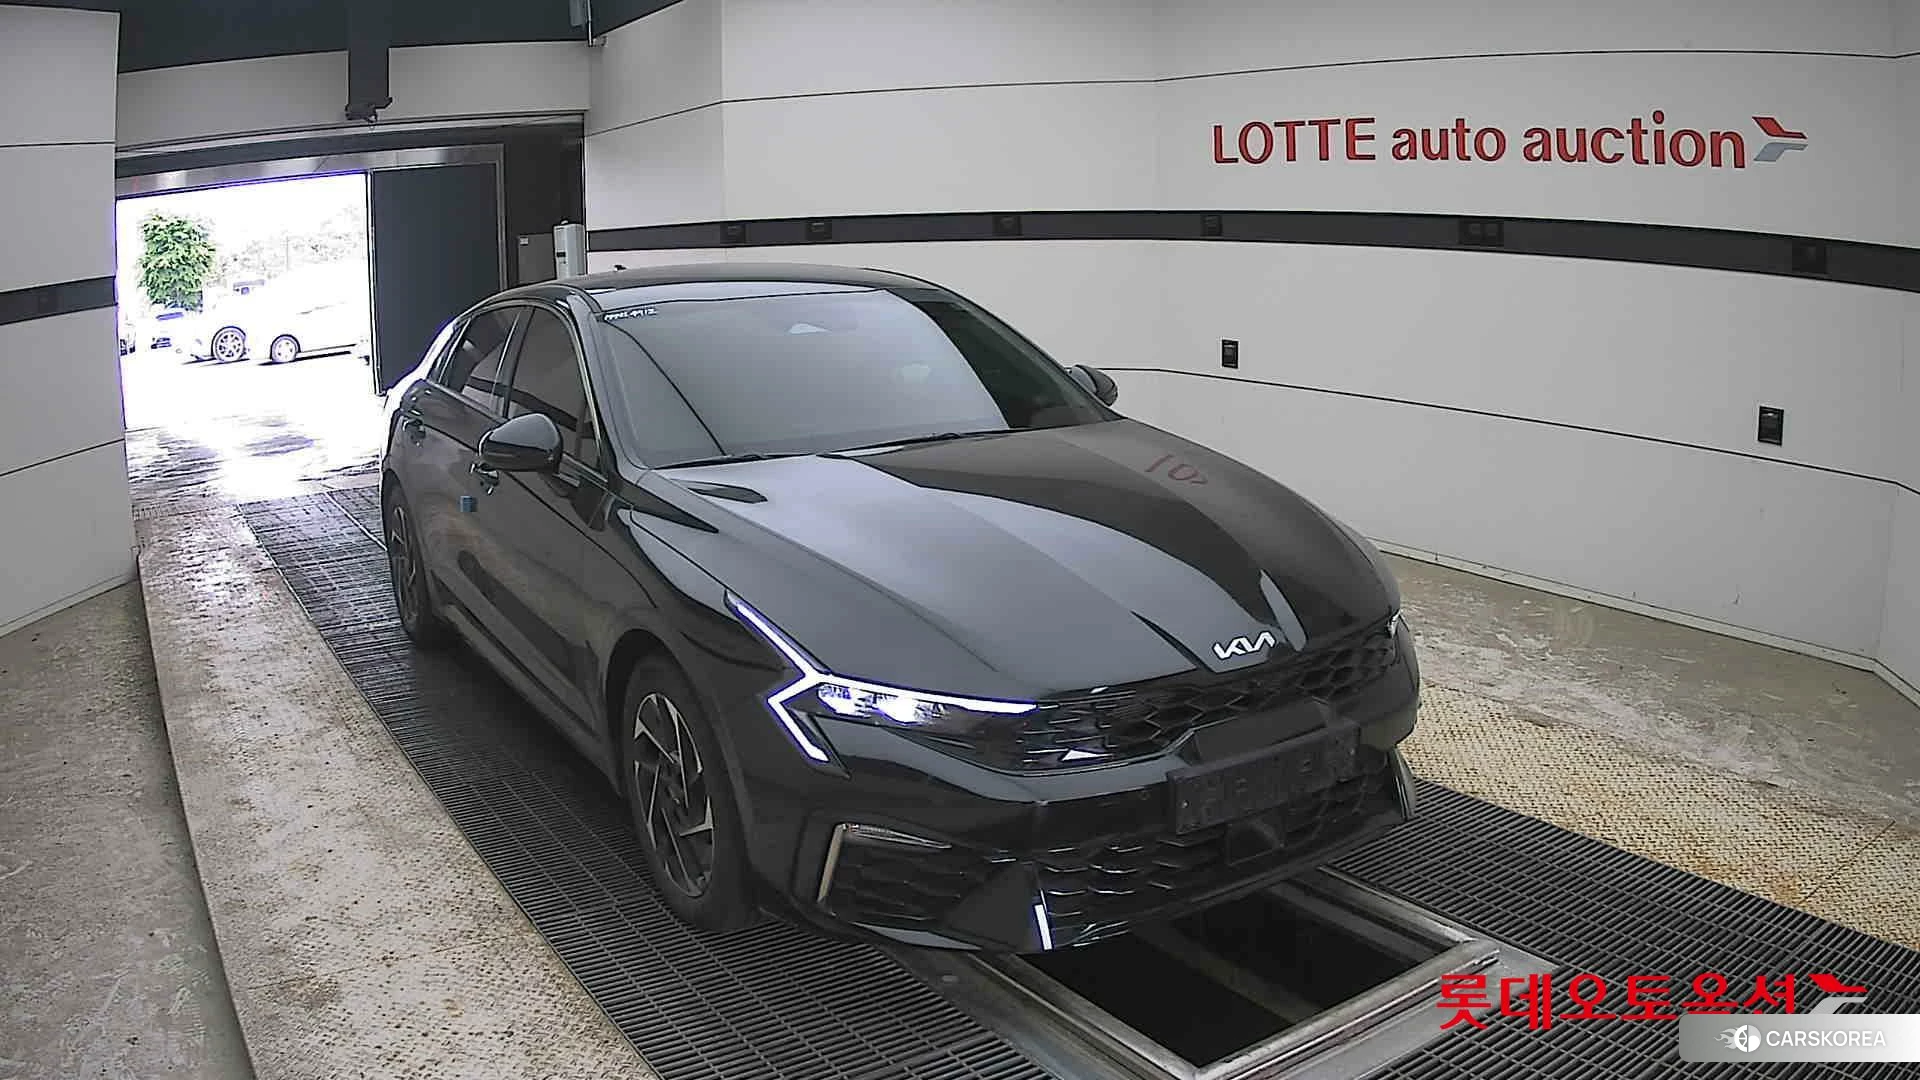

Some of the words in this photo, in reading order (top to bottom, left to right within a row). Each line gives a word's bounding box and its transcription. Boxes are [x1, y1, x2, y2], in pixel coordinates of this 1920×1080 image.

[1212, 117, 1377, 163] LOTTE
[1392, 117, 1507, 161] auto
[1523, 110, 1746, 168] auction
